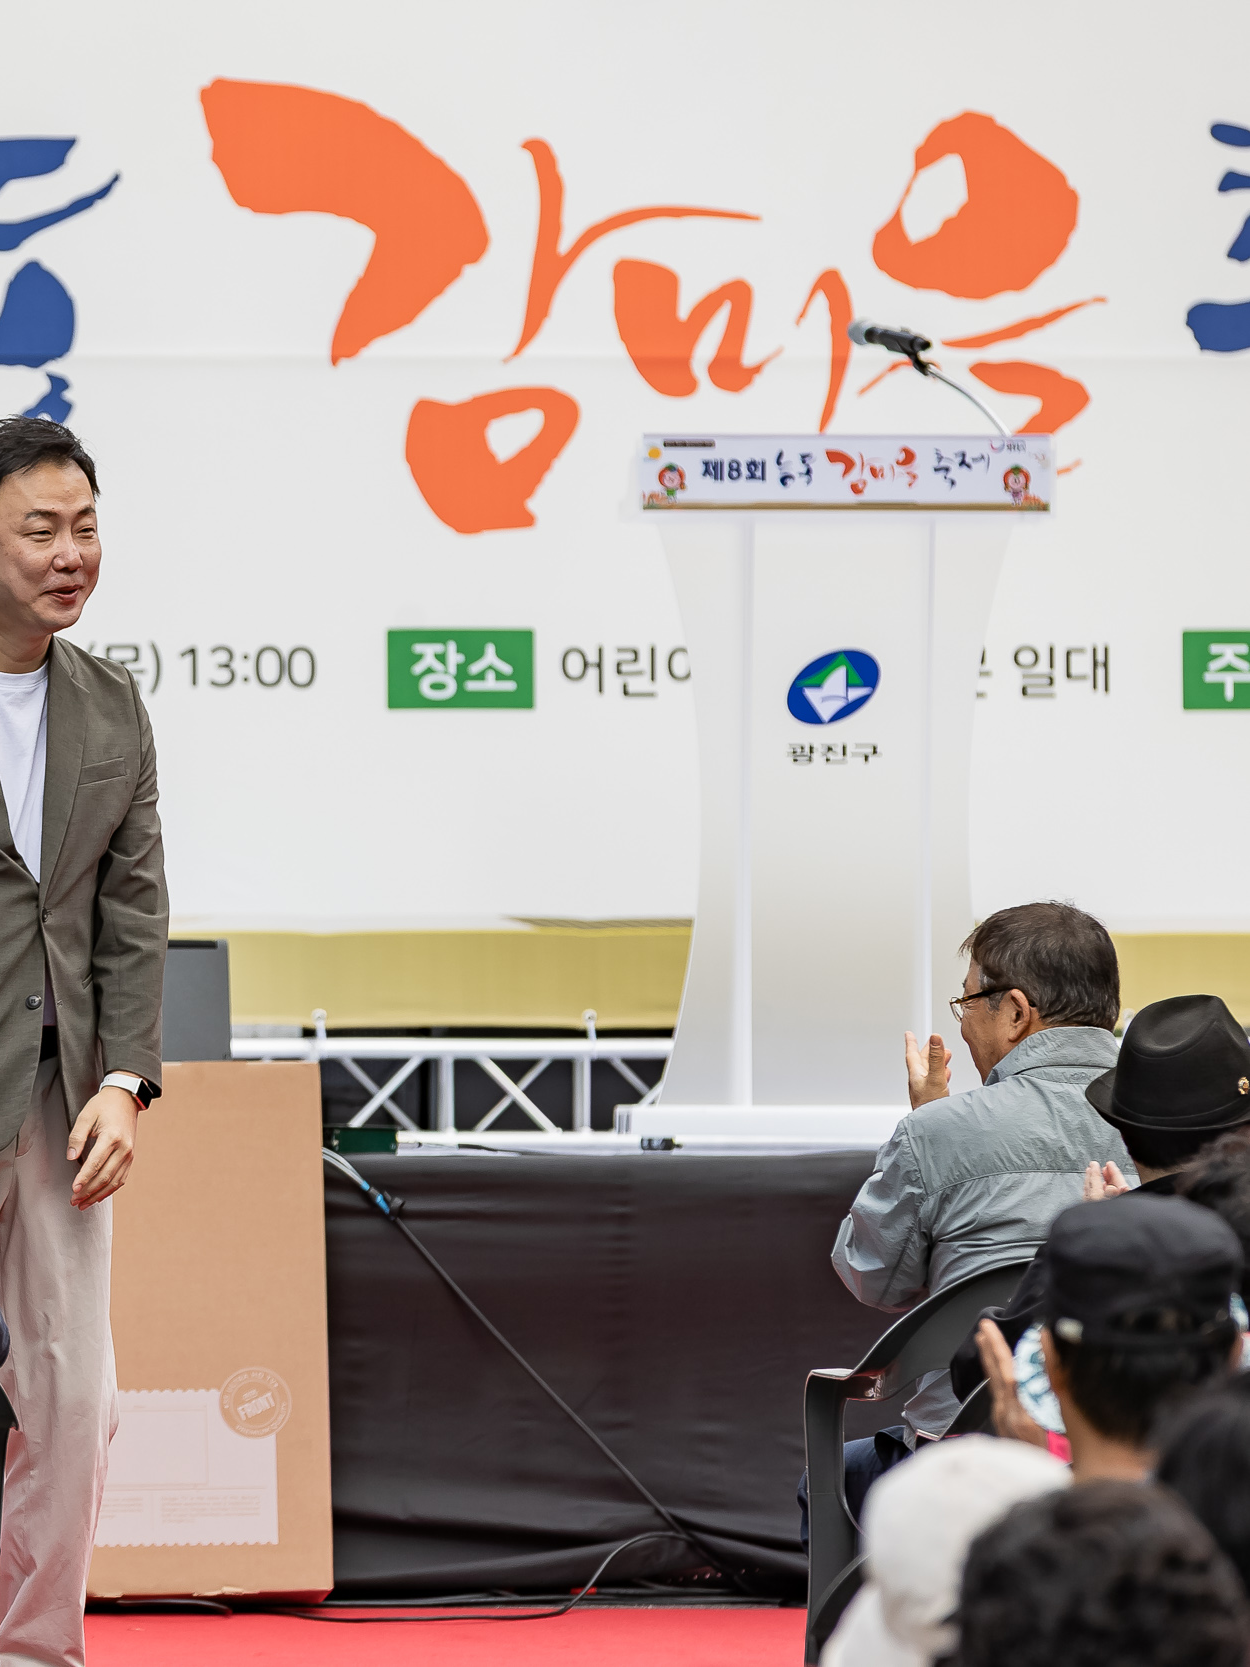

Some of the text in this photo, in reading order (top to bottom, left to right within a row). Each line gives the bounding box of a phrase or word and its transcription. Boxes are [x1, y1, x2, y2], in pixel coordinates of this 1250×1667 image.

[702, 458, 767, 482] 제8회
[180, 645, 318, 689] 13:00
[410, 640, 518, 701] 장소
[1013, 643, 1110, 698] 일대
[787, 742, 883, 766] 광진구
